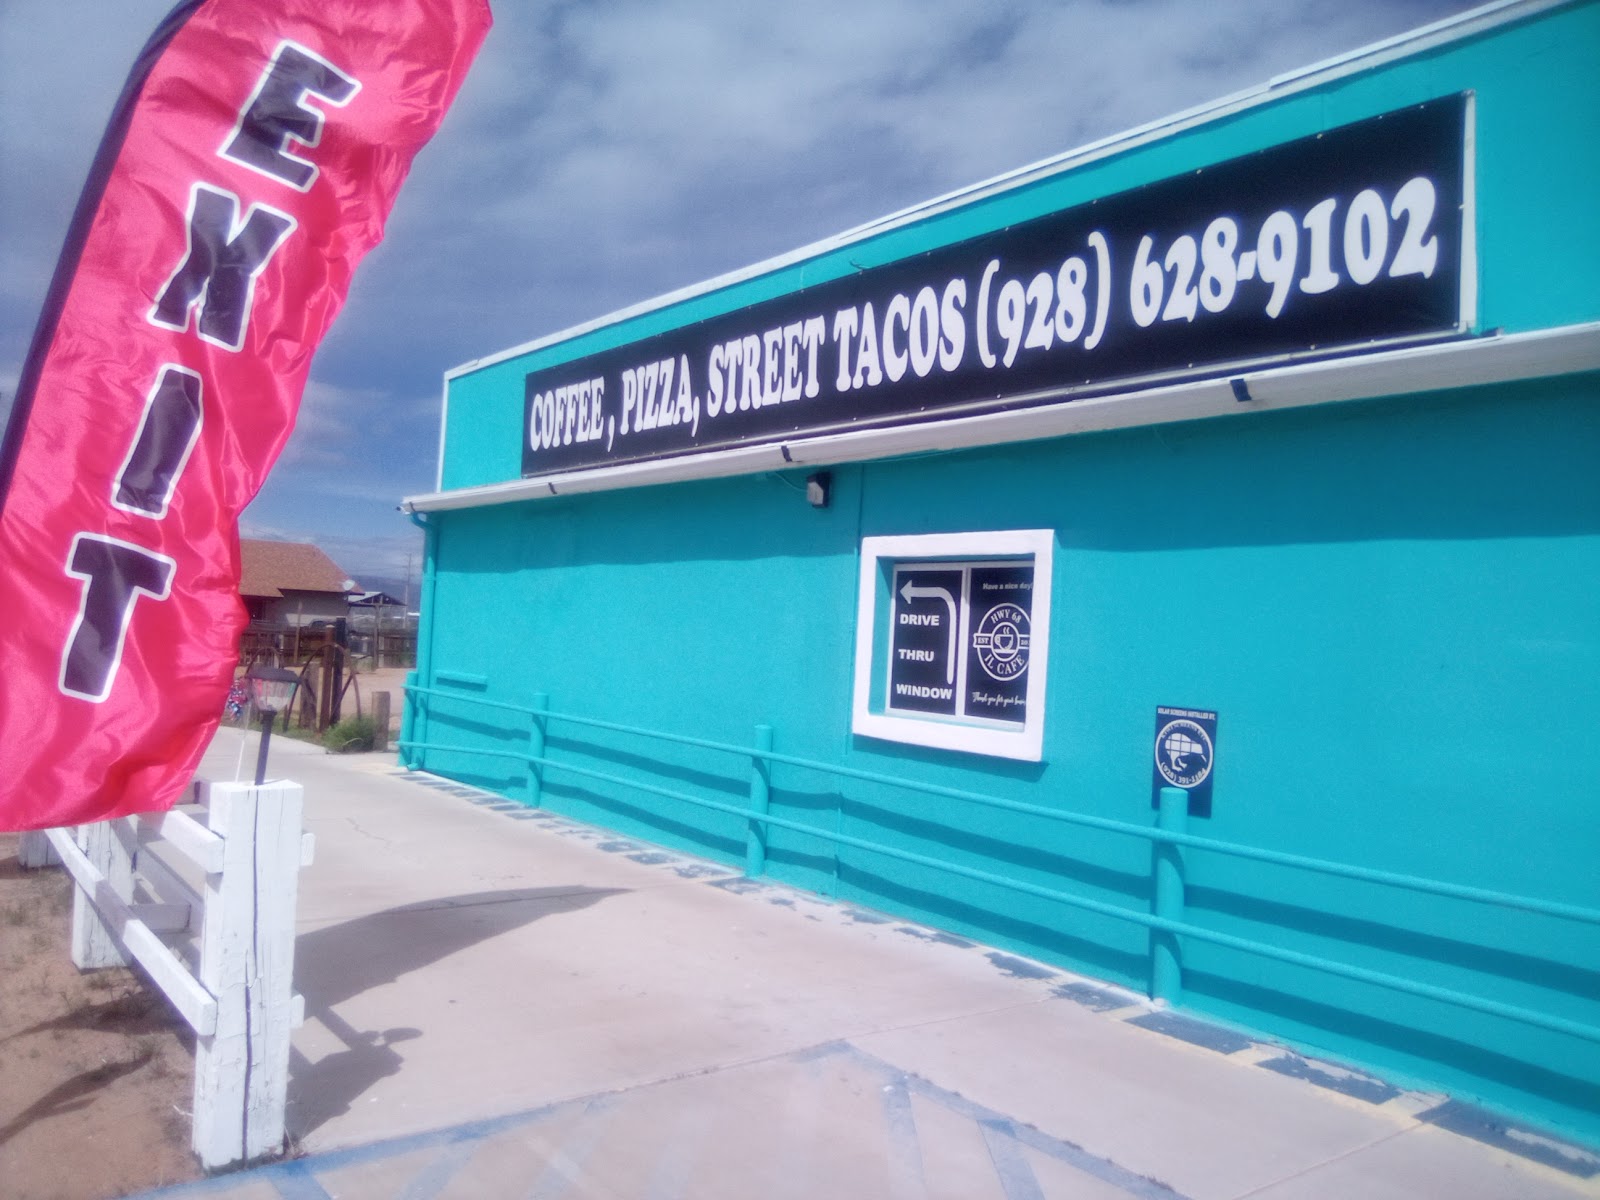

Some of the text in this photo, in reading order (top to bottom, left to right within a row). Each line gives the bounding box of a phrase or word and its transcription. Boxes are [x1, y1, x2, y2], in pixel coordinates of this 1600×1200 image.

[530, 176, 1438, 452] COFFEE, PIZZA, STREET TACOS (928) 628-9102
[58, 40, 362, 703] EXIT
[900, 613, 940, 627] DRIVE
[990, 608, 1022, 624] HWY 68
[898, 649, 934, 662] THRU
[984, 653, 1025, 675] IL CAFE
[896, 684, 953, 700] WINDOW
[972, 691, 988, 703] Thank
